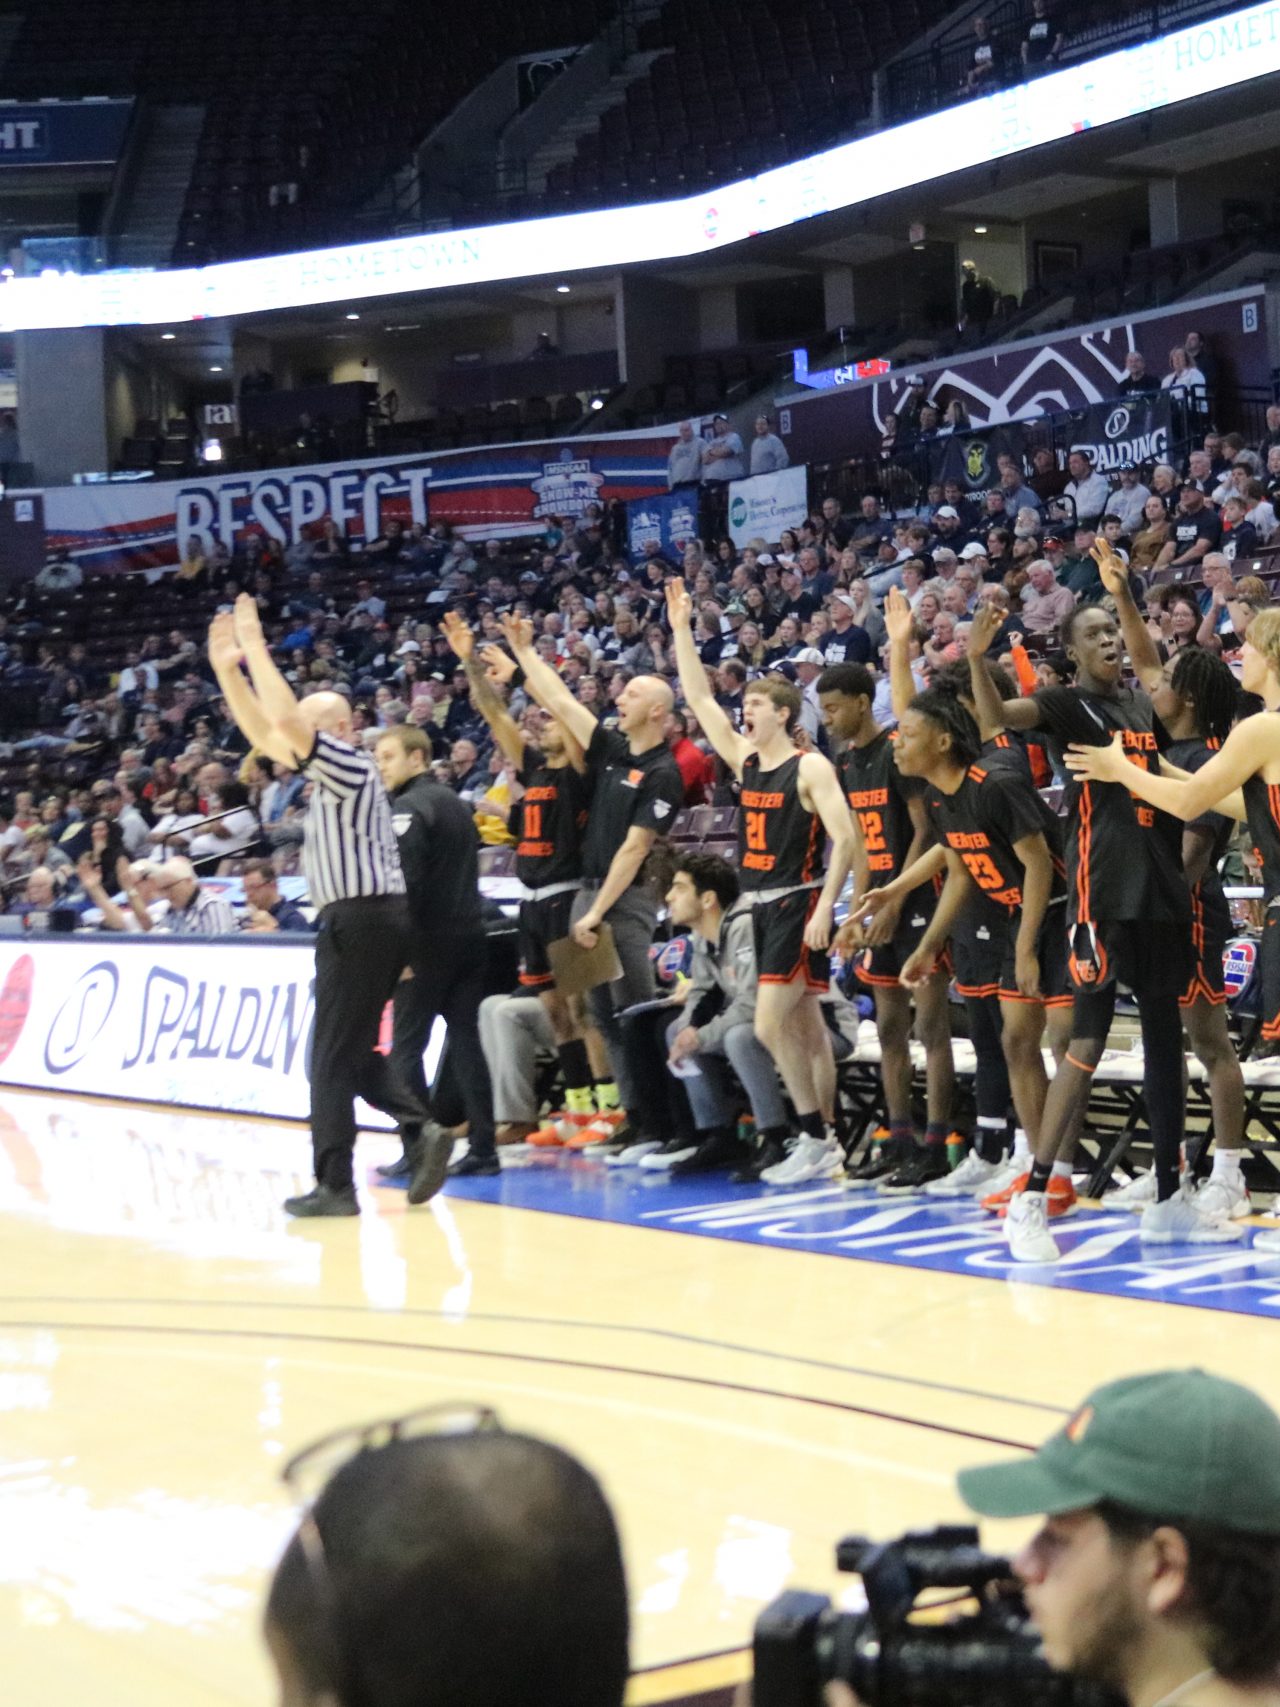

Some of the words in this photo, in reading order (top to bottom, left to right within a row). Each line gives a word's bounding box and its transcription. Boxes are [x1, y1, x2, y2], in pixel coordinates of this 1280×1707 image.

[300, 237, 482, 287] HOMETOWN
[1245, 309, 1255, 328] B
[524, 804, 542, 838] 11
[745, 811, 767, 851] 21
[121, 965, 316, 1076] SPALDIN
